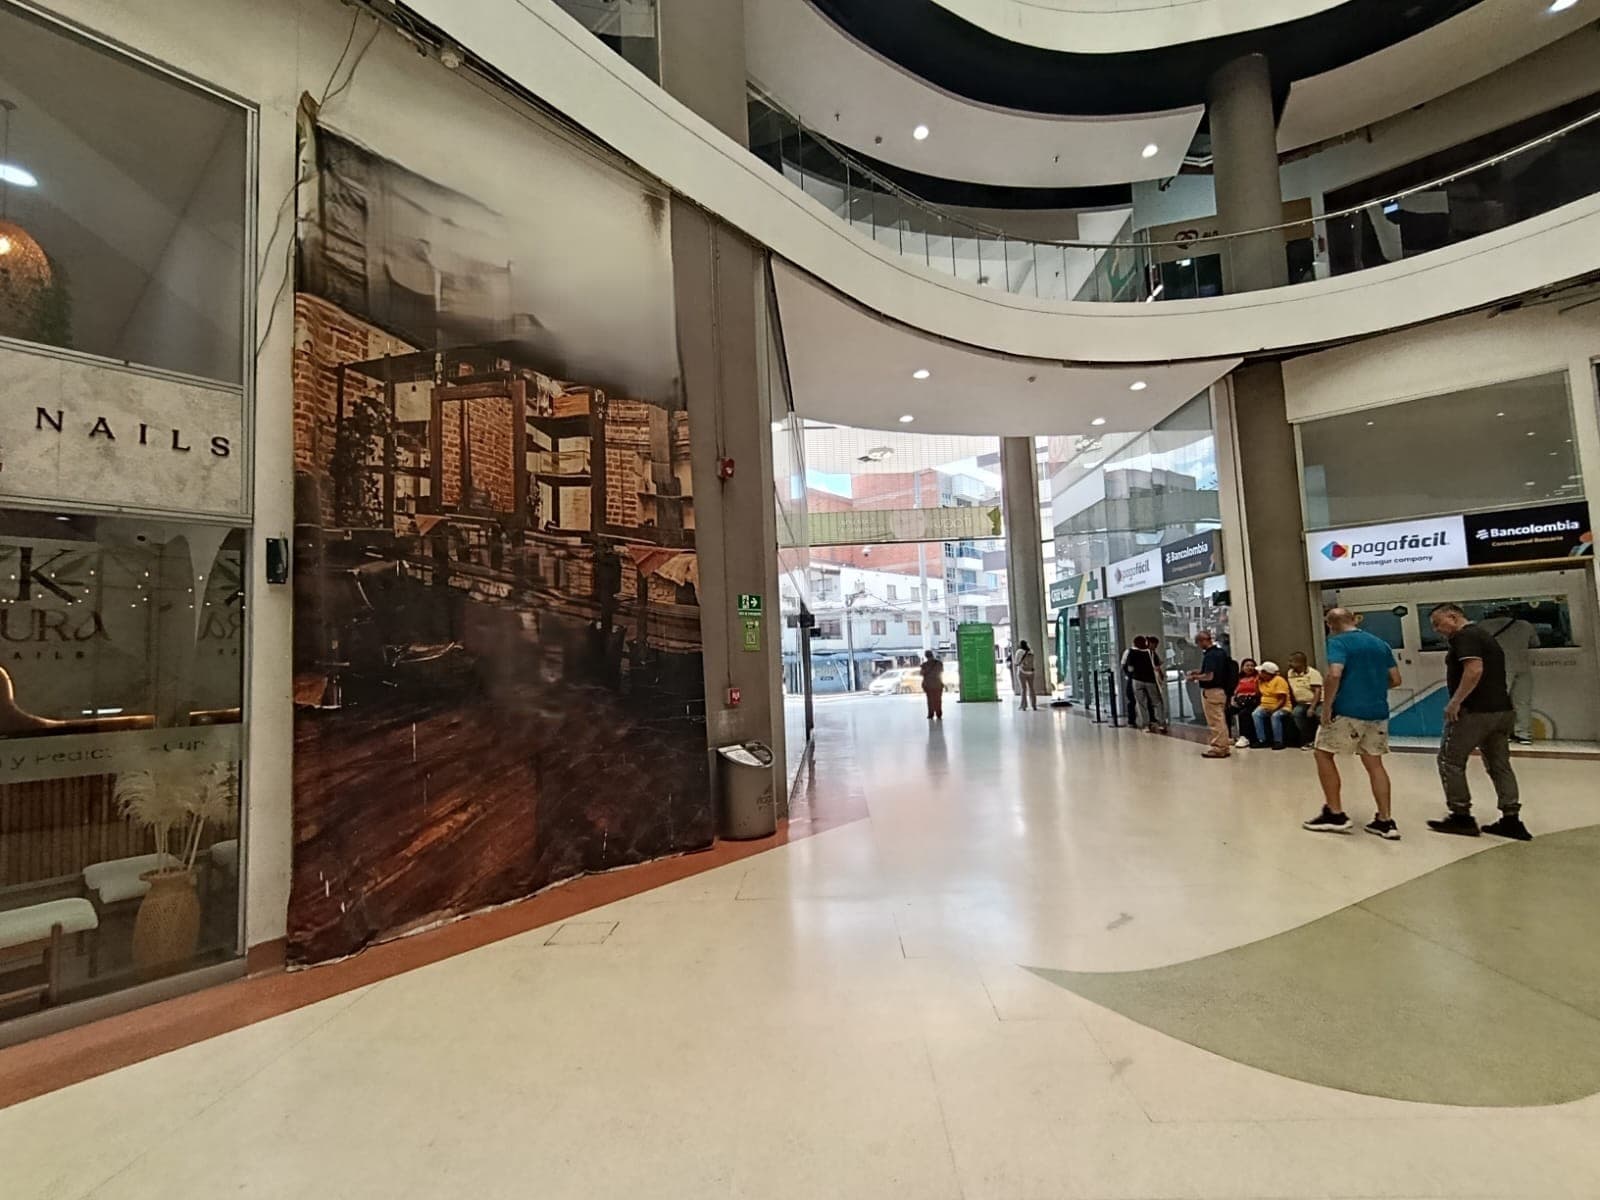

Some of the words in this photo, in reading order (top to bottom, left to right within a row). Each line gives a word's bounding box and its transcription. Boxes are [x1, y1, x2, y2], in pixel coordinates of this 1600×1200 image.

[35, 406, 231, 458] NAILS
[1490, 520, 1580, 538] Bancolombia
[1358, 558, 1392, 567] Prosegur
[1394, 555, 1433, 564] company
